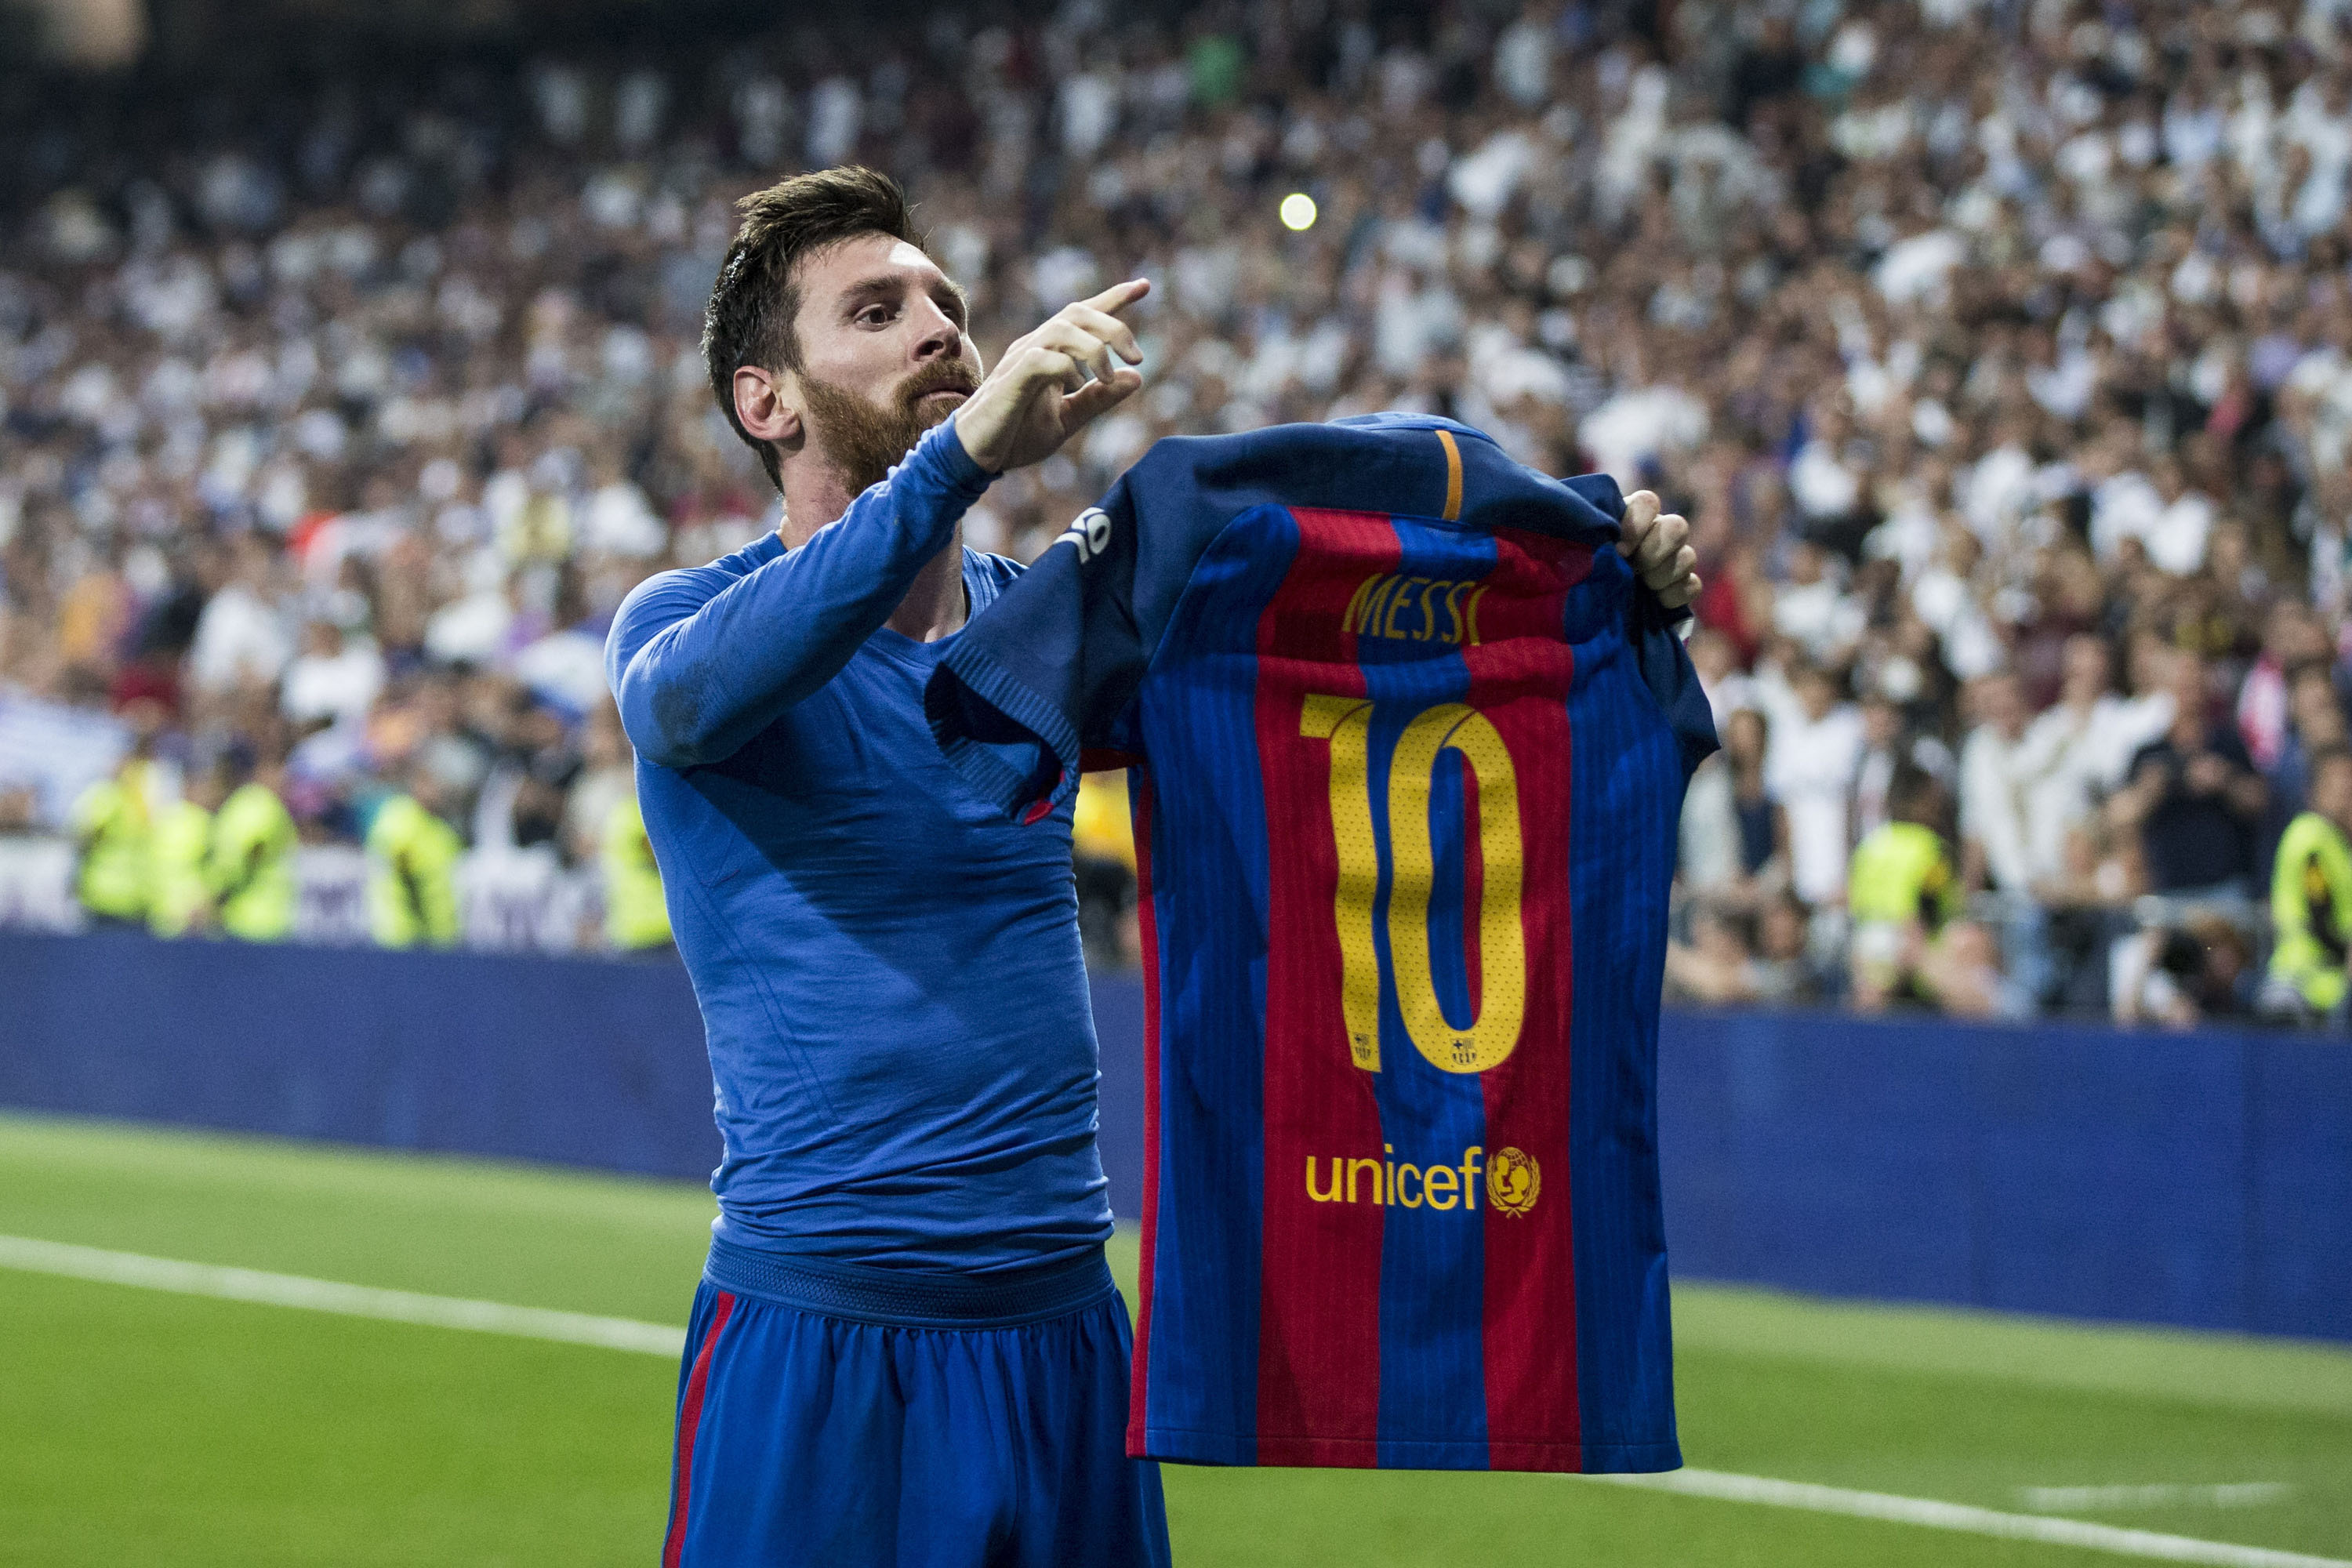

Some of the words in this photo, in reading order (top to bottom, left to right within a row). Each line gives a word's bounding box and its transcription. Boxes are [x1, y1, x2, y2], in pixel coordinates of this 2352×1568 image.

[1341, 572, 1490, 647] MESSI
[1299, 693, 1526, 1074] 10
[1305, 1143, 1483, 1210] unicef
